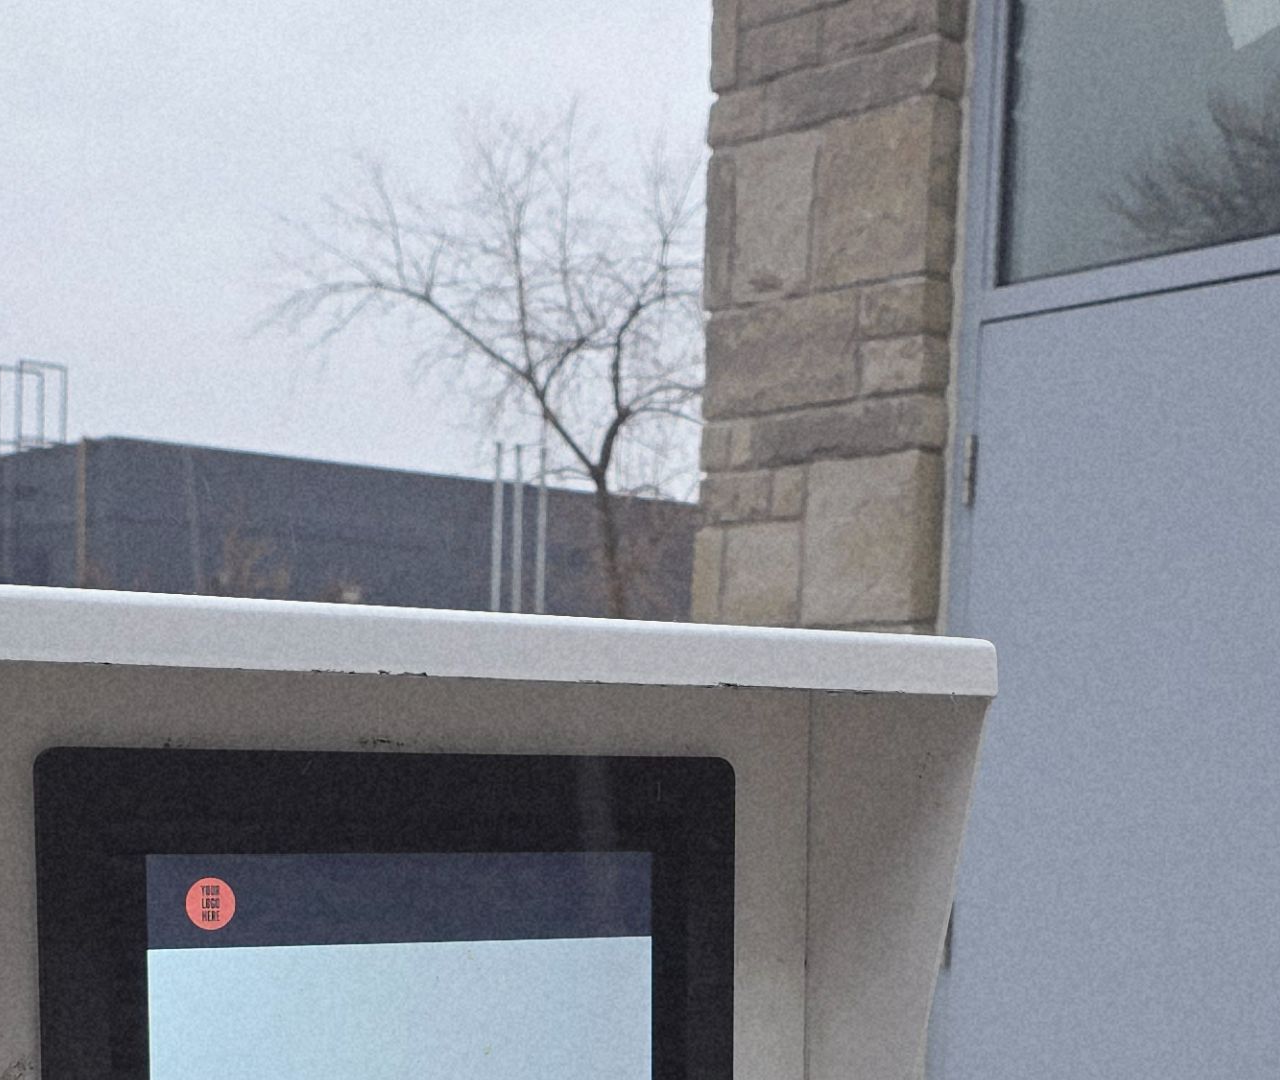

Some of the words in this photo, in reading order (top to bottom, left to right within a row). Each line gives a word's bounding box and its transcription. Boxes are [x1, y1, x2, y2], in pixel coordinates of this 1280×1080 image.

[200, 885, 220, 896] YOUR
[201, 897, 220, 909] LOGO
[201, 910, 220, 922] HERE
